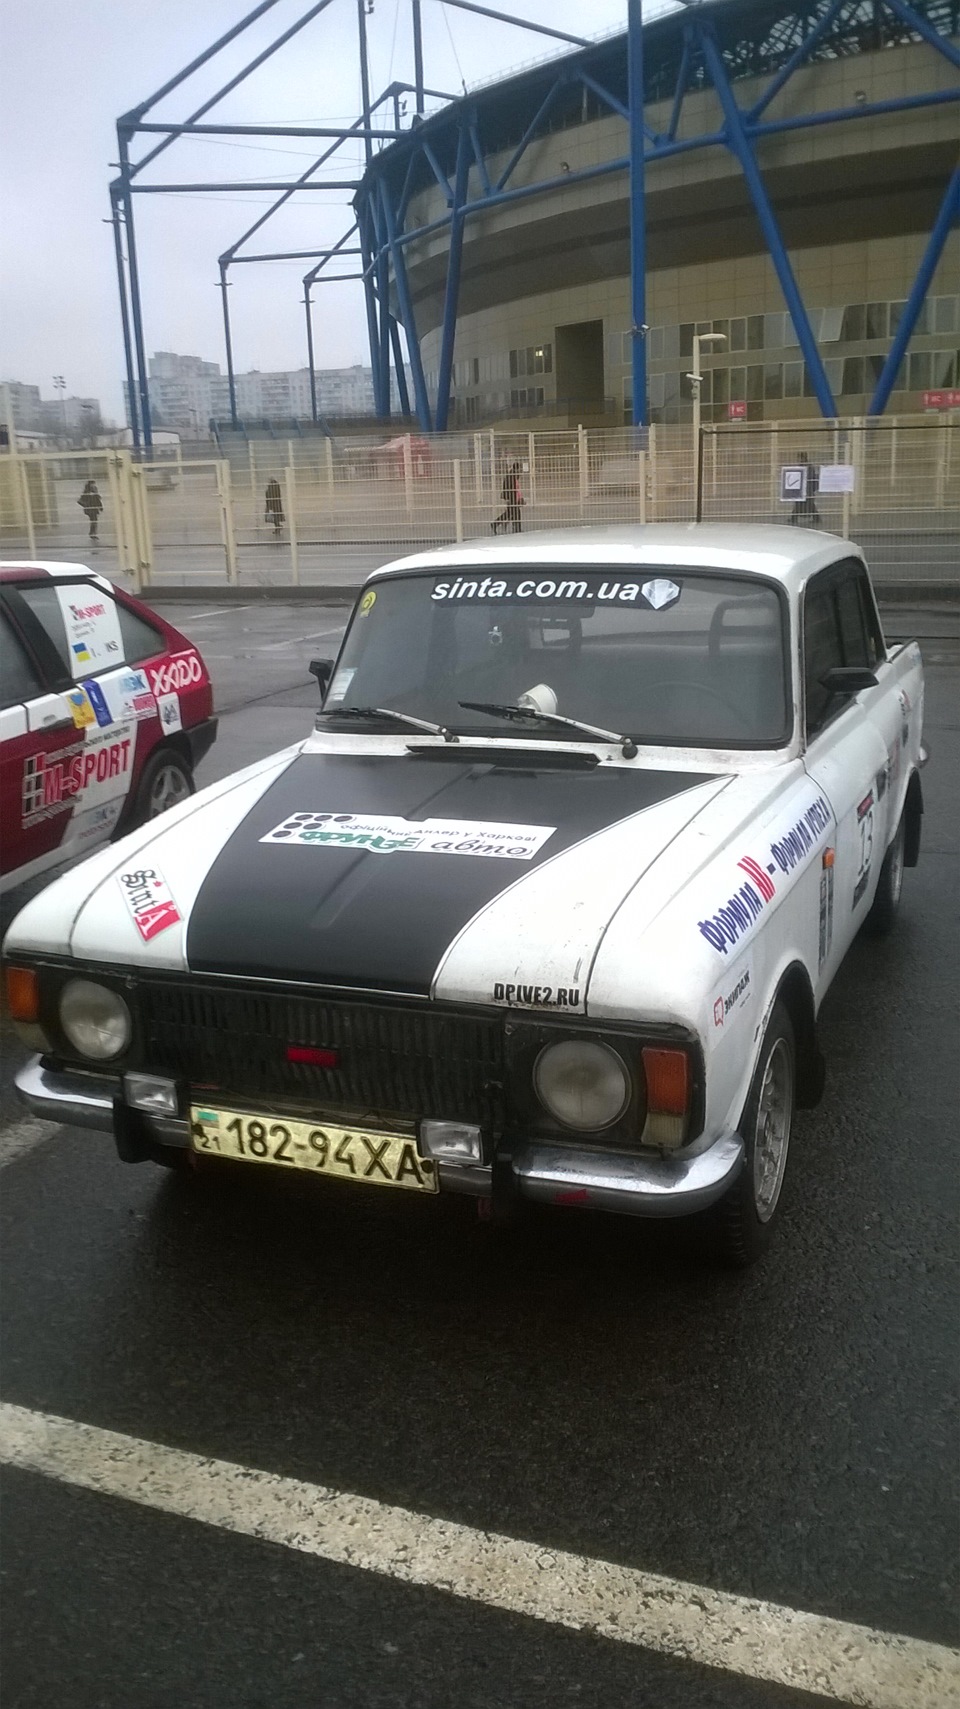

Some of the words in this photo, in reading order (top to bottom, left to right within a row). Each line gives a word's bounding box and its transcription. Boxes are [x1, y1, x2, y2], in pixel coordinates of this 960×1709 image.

[431, 576, 639, 601] sinta.com.ua
[149, 655, 202, 697] XADO
[43, 738, 131, 806] M-SPORT
[430, 838, 529, 856] авто
[697, 881, 763, 955] ФОРМУЛА
